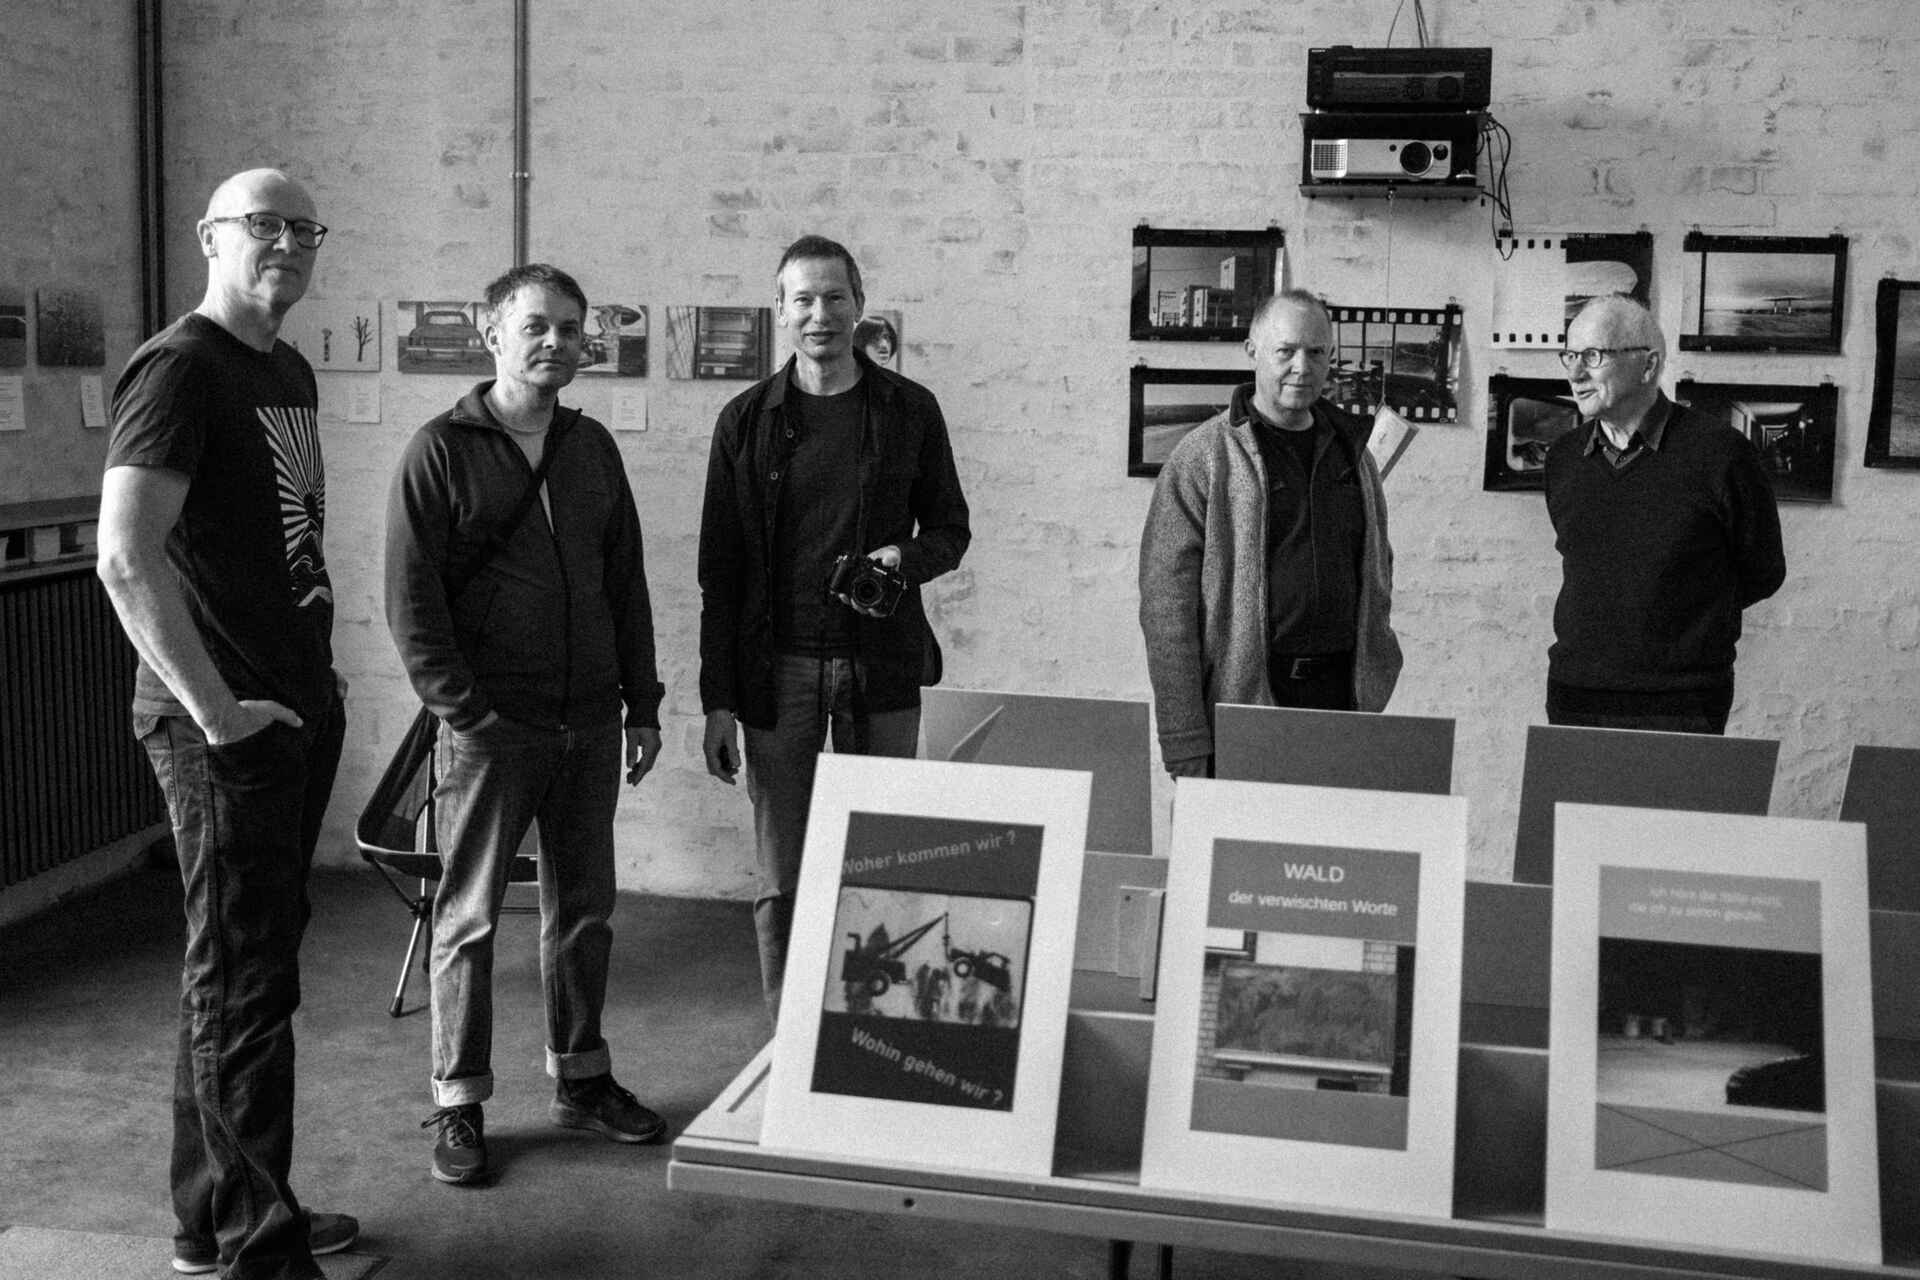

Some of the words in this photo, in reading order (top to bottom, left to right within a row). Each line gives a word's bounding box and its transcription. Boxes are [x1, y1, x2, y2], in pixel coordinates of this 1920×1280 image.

[897, 841, 971, 865] kommen
[975, 833, 1002, 850] wir
[1283, 862, 1345, 884] WALD
[1228, 889, 1253, 905] der
[1257, 893, 1348, 912] verwischten
[1352, 899, 1399, 917] Worte
[851, 1027, 901, 1062] Wohin
[903, 1055, 956, 1087] gehen
[960, 1080, 988, 1099] wir
